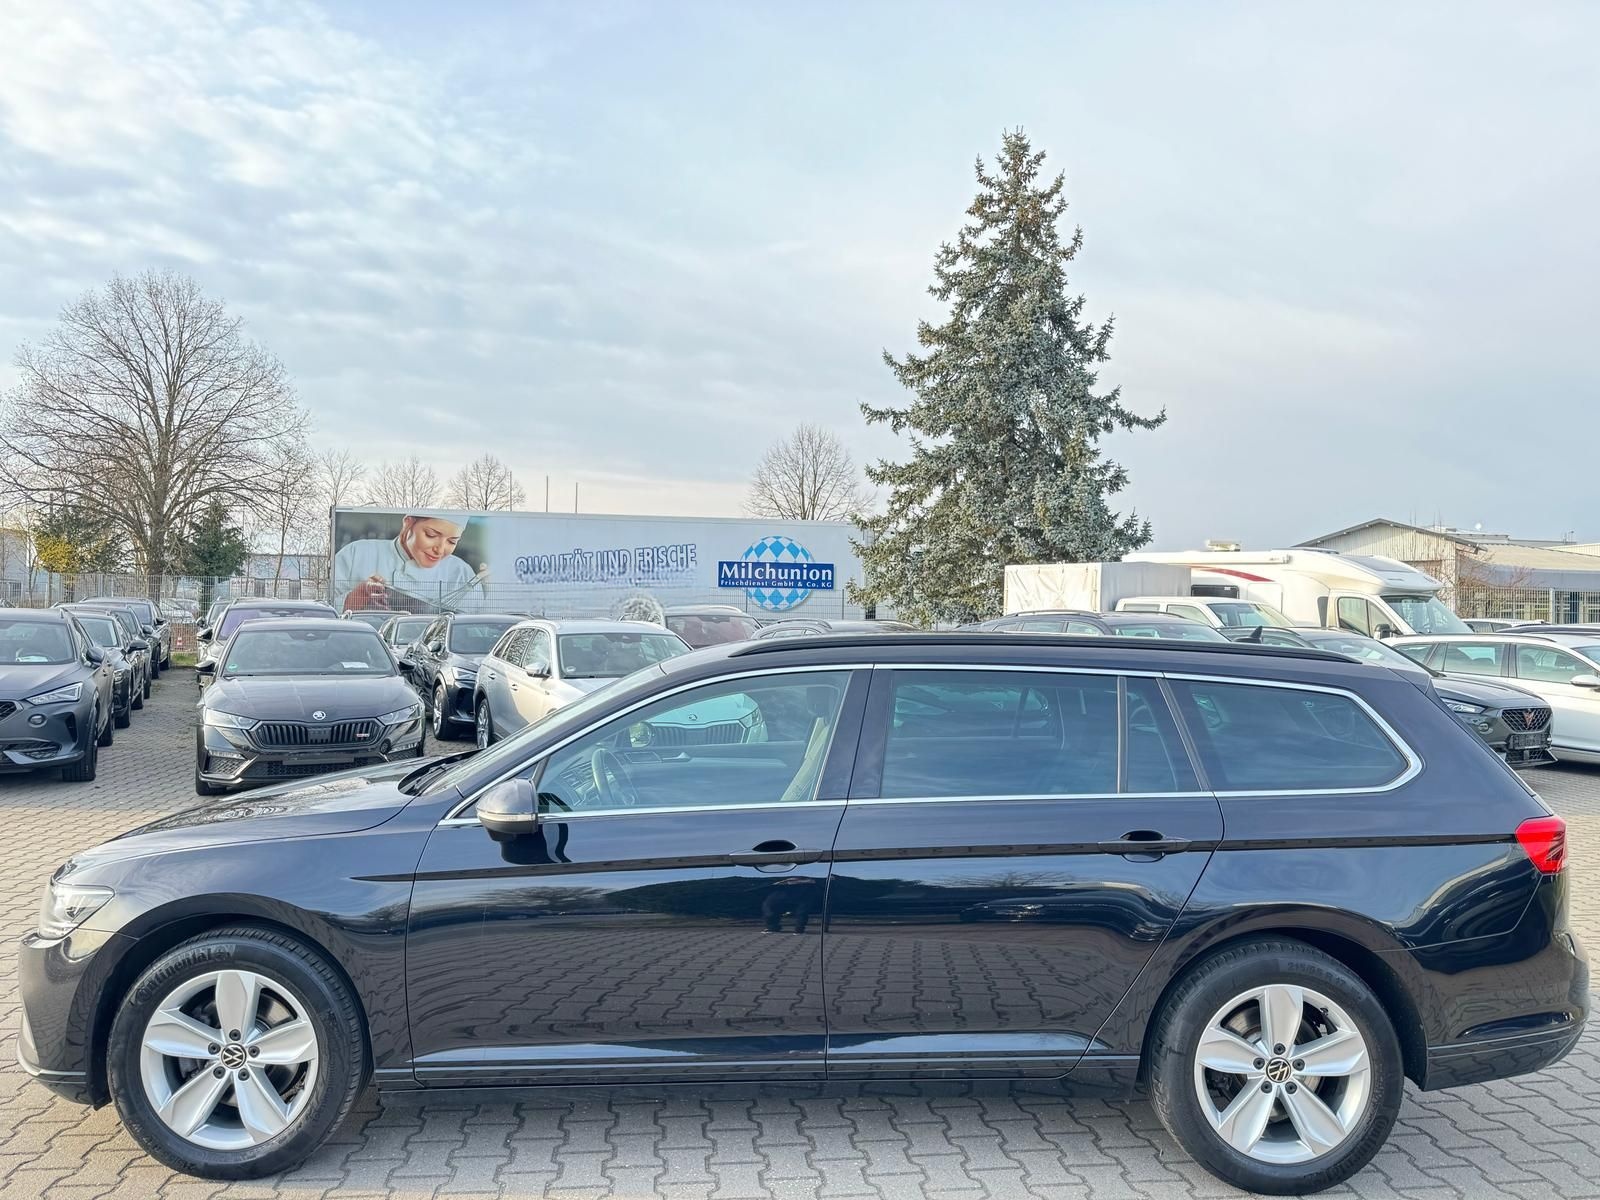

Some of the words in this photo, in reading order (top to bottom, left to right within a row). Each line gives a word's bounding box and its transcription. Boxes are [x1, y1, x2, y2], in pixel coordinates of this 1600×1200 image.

[514, 549, 594, 583] QUALITÄT
[596, 549, 632, 583] UND
[633, 544, 697, 580] FRISCHE
[721, 562, 832, 581] Milchunion
[720, 579, 768, 587] Frischdienst
[771, 580, 794, 588] GmbH
